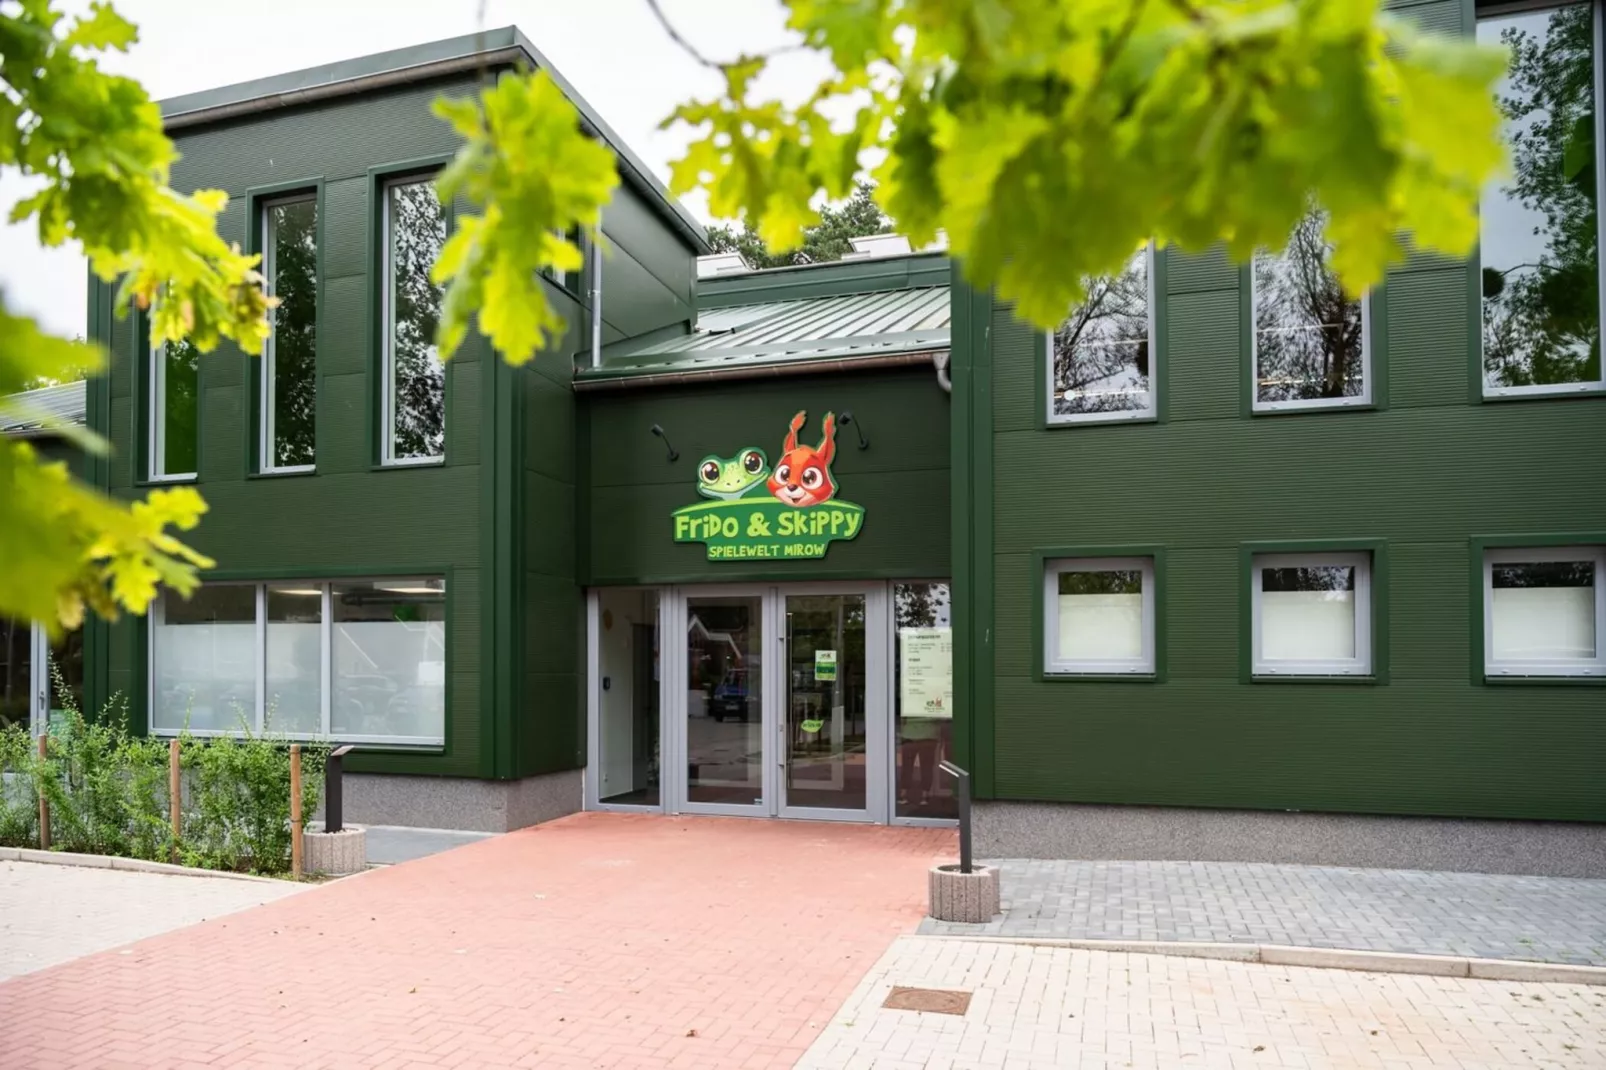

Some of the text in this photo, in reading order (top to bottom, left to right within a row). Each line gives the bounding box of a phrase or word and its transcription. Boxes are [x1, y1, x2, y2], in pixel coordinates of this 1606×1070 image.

[746, 512, 772, 537] &
[708, 543, 826, 558] SPIELEWELT MIROW
